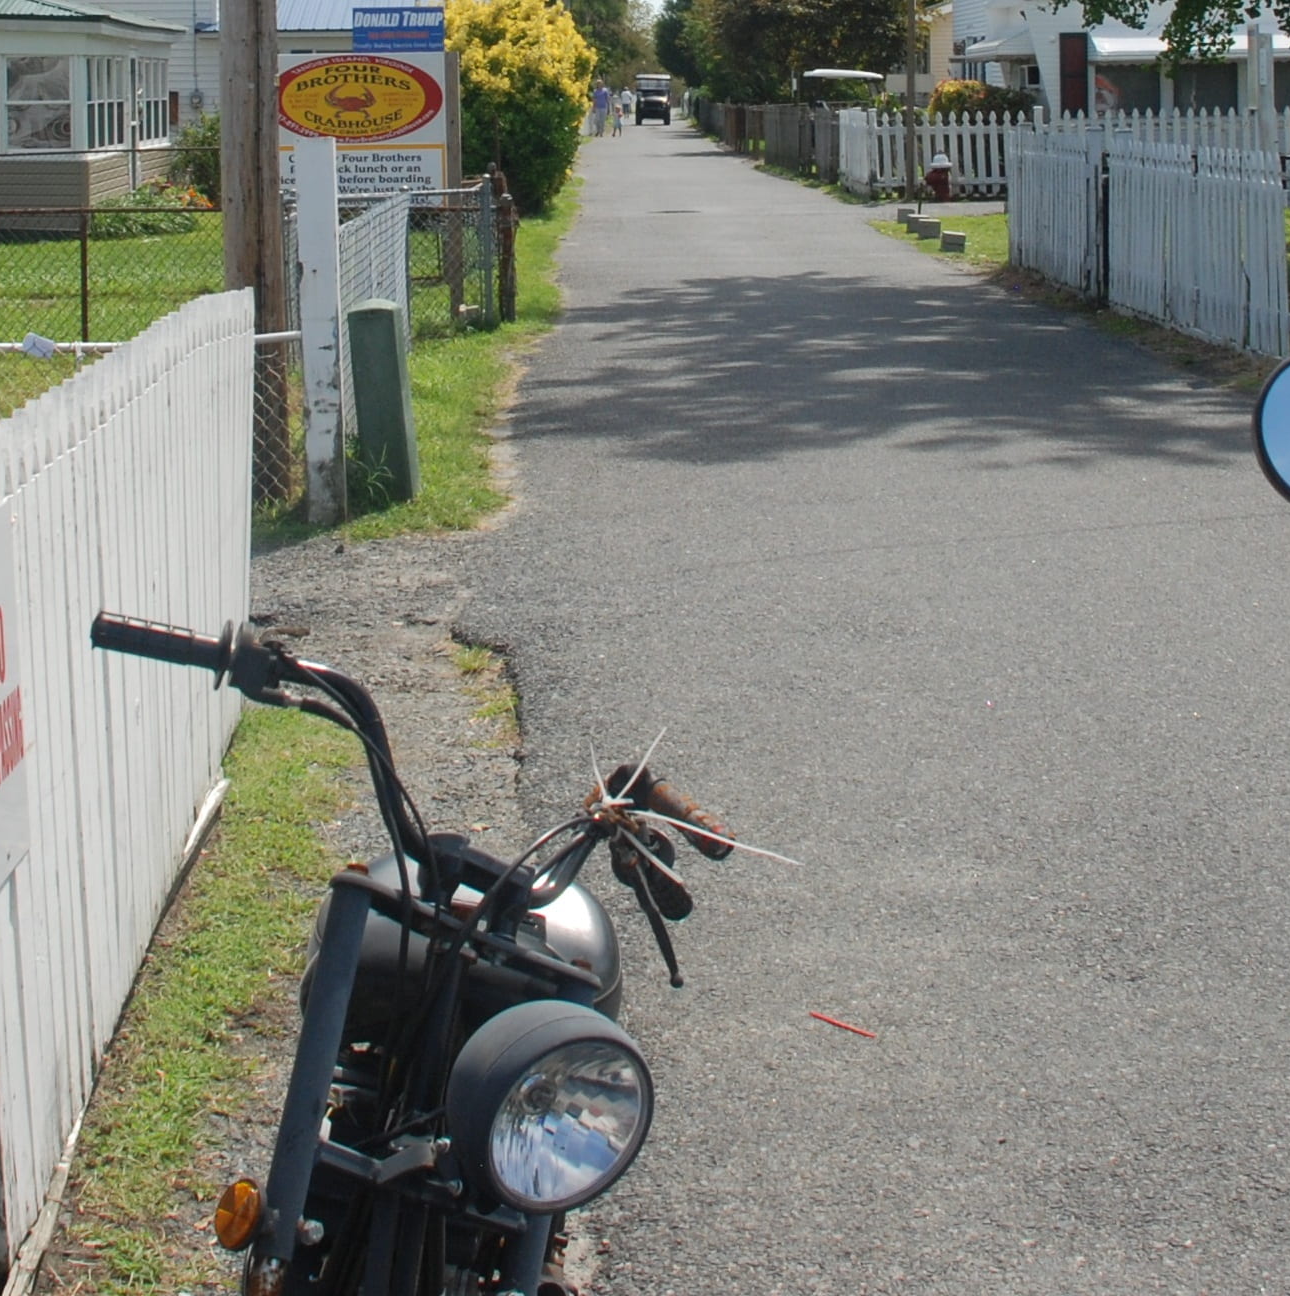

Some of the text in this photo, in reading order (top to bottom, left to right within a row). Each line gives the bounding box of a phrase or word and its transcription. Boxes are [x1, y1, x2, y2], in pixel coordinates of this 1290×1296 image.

[354, 11, 443, 27] DONALD TRUMP
[324, 65, 381, 75] FOUR
[296, 73, 411, 92] BROTHERS
[304, 109, 403, 129] CRABHOUSE
[342, 154, 422, 162] Four Brothers
[354, 164, 388, 173] lunch
[339, 175, 376, 184] before
[379, 174, 432, 185] boarding
